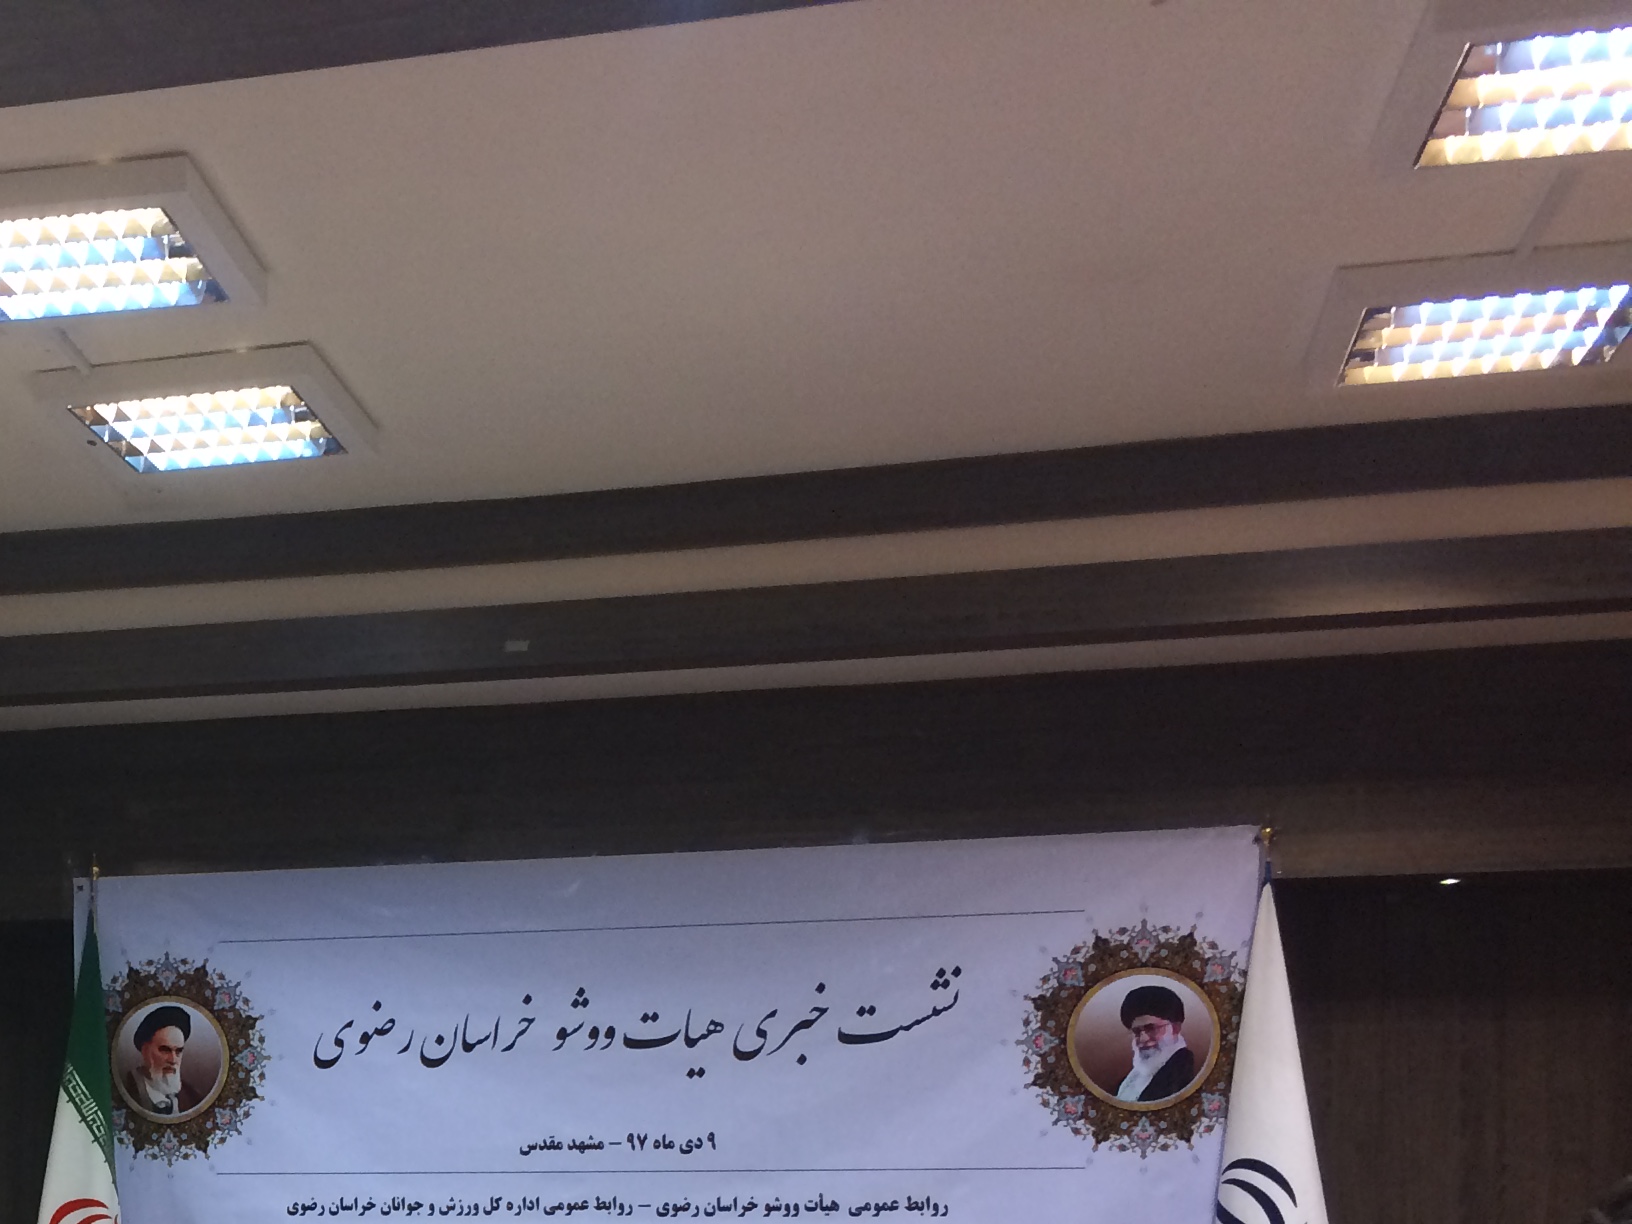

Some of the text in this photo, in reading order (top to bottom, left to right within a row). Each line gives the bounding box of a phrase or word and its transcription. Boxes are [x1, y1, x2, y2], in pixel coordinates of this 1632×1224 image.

[838, 965, 962, 1044] نشست
[552, 987, 616, 1051] ووشو
[733, 982, 829, 1065] خبری
[313, 1000, 414, 1069] رضوی
[420, 994, 536, 1068] خراسان
[519, 1135, 564, 1156] مقدس
[567, 1135, 605, 1154] مشهد
[626, 1132, 648, 1151] ۹۷
[653, 1133, 675, 1150] ماه
[679, 1136, 703, 1155] دی
[286, 1197, 326, 1217] رضوی
[328, 1196, 377, 1217] خراسان
[380, 1196, 424, 1217] جوانان
[427, 1203, 435, 1216] و
[438, 1197, 480, 1217] ورزش
[483, 1196, 502, 1216] کل
[506, 1197, 540, 1216] اداره
[543, 1197, 590, 1216] عمومی
[593, 1196, 633, 1217] روابط
[655, 1197, 700, 1217] رضوی
[703, 1196, 758, 1217] خراسان
[763, 1197, 800, 1217] ووشو
[848, 1198, 899, 1217] عمومی
[904, 1195, 949, 1217] روابط
